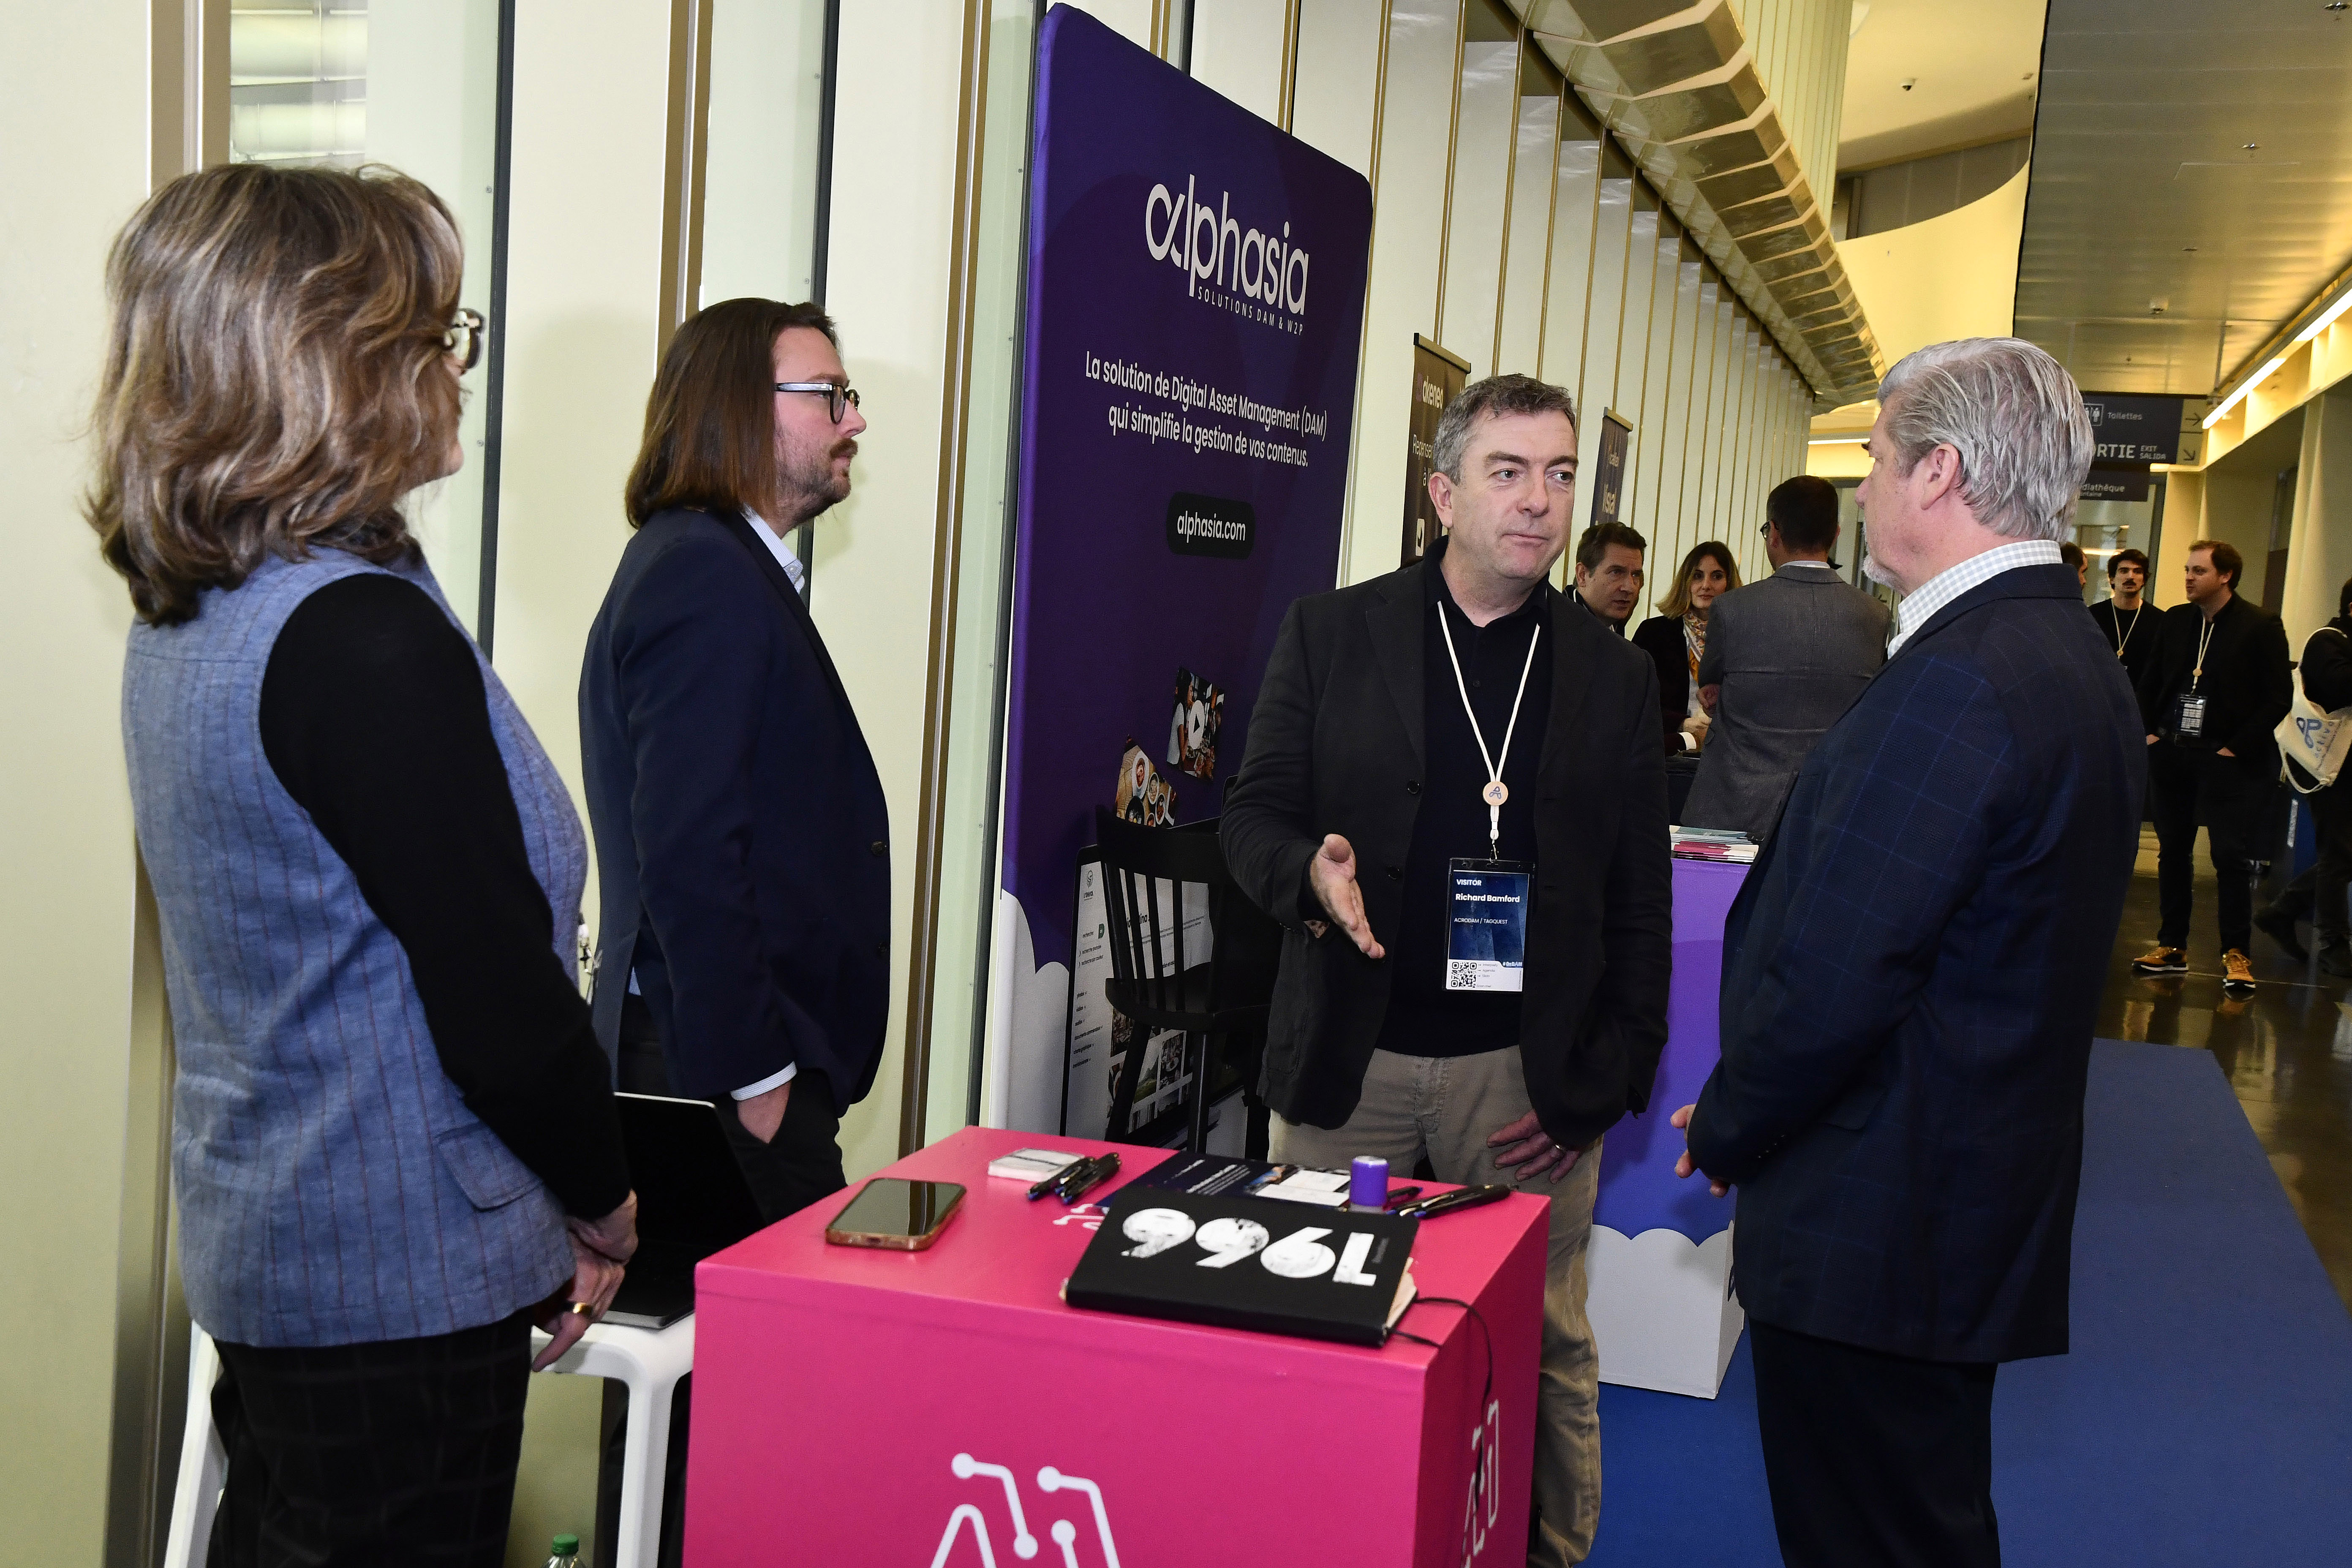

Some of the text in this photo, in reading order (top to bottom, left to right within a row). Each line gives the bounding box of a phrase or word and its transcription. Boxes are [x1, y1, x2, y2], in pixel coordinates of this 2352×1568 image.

[1146, 174, 1309, 315] alphasia
[1198, 286, 1303, 336] SOLUTIONS DAM & W2P
[1086, 351, 1327, 442] La solution de Digital Asset Management (DAM)
[1423, 376, 1443, 410] akeneo
[1109, 401, 1308, 467] qui simplifie la gestion de vos contenus.
[2096, 443, 2136, 459] RTIE
[1177, 510, 1246, 543] alphasia.com
[1456, 893, 1520, 903] Richard Bamford
